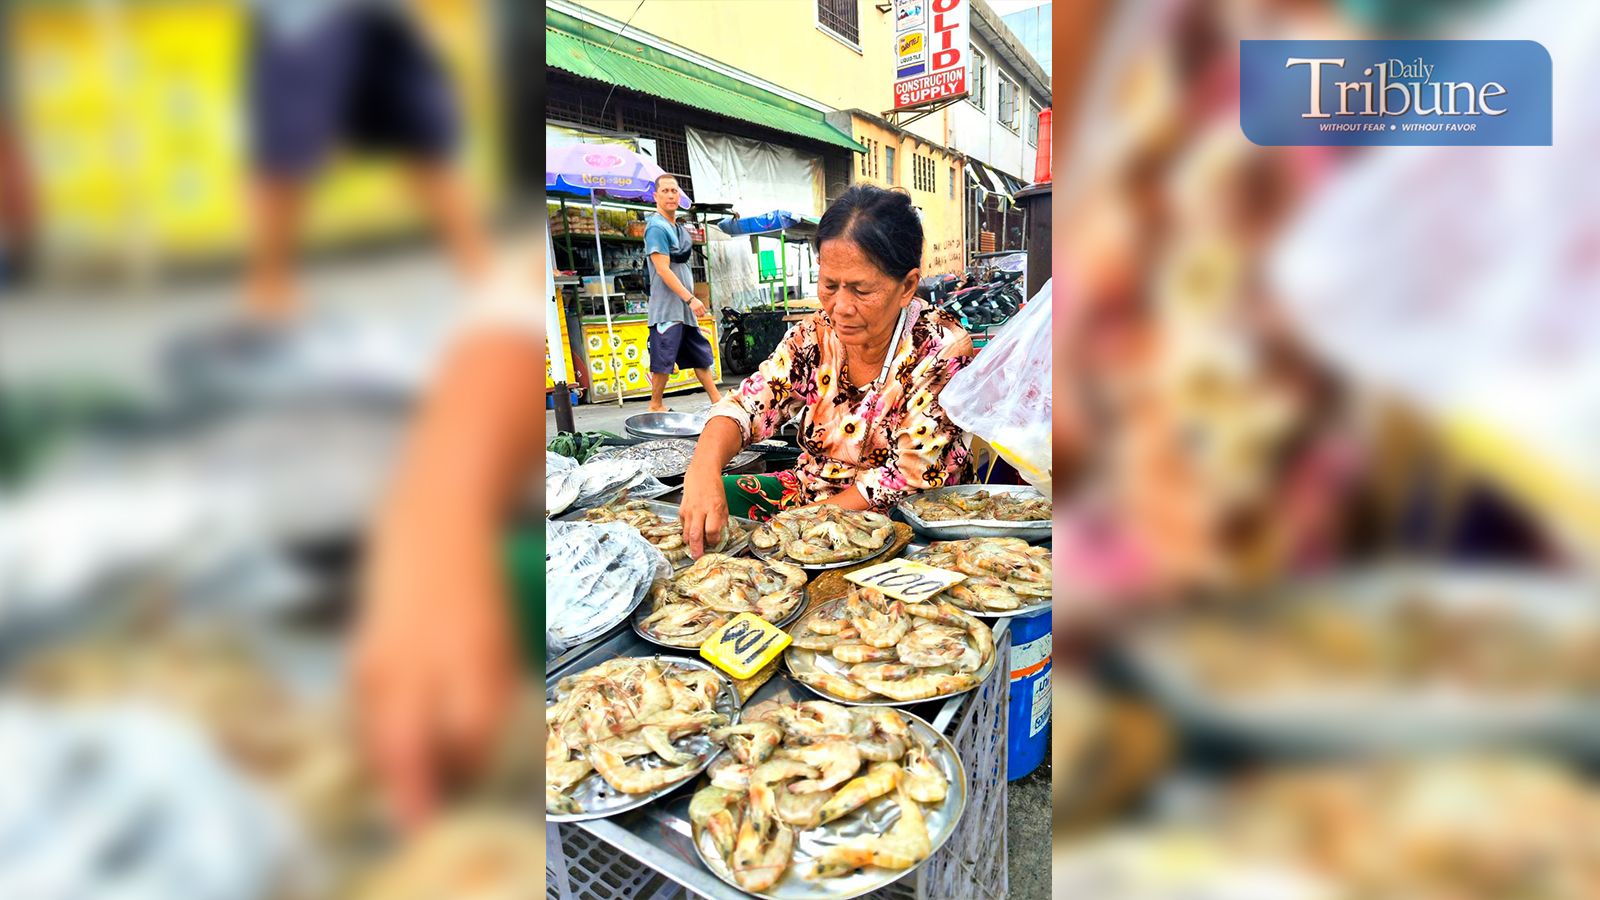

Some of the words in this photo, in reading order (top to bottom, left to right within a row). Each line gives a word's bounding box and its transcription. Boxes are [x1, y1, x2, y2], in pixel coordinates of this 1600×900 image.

[895, 69, 963, 95] CONSTRUCTION
[900, 82, 959, 105] SUPPLY
[861, 567, 944, 596] 100
